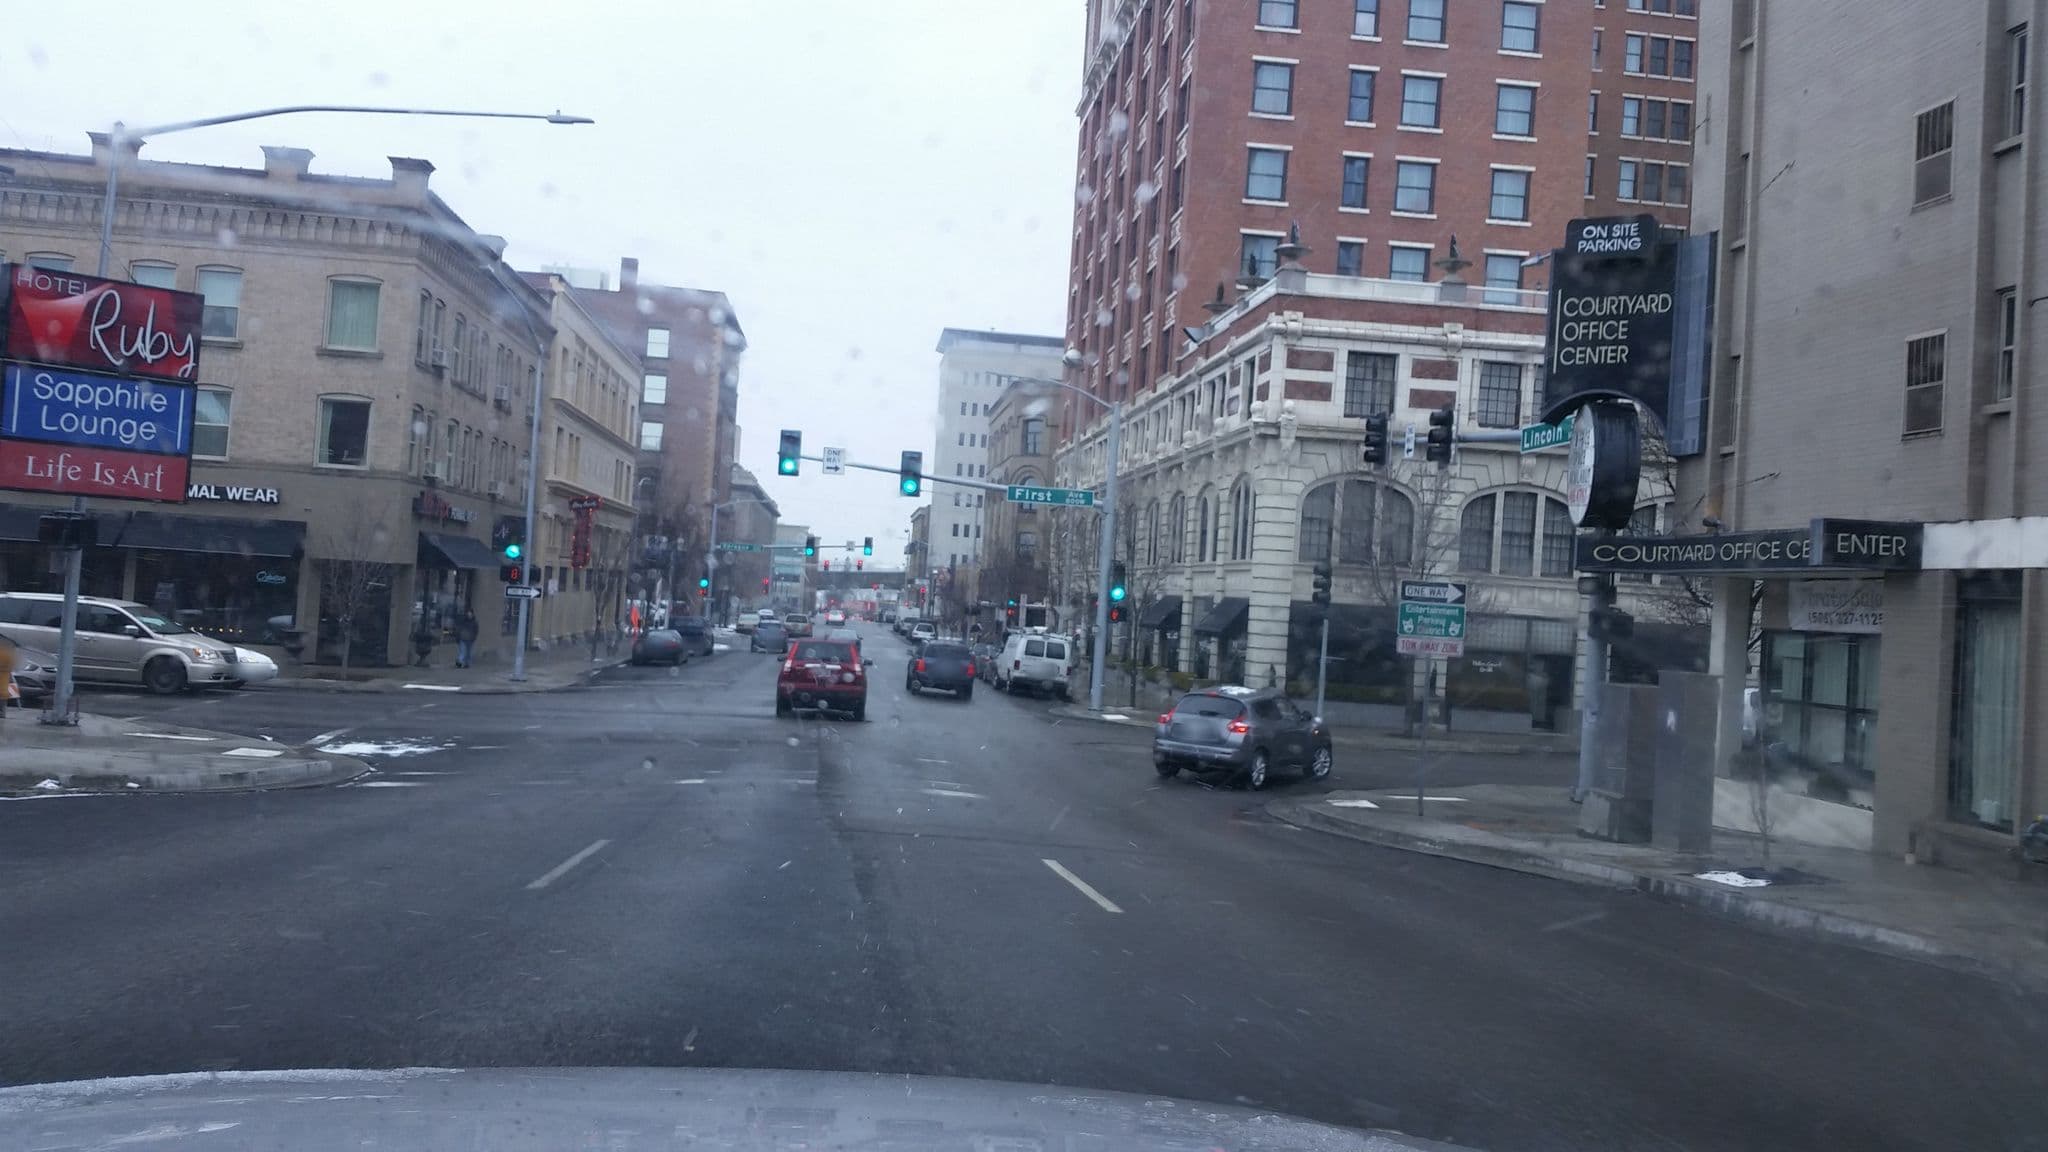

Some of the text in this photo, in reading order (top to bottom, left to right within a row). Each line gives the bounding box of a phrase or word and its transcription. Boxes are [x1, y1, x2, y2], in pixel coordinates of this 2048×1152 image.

[1582, 223, 1640, 239] ON SITE
[1577, 237, 1642, 253] PARKING
[15, 273, 88, 296] HOTEL
[1562, 293, 1672, 317] COURTYARD
[89, 288, 197, 379] Ruby
[1562, 319, 1629, 342] OFFICE
[1559, 345, 1629, 366] CENTER
[32, 372, 168, 413] Sapphire
[40, 404, 157, 445] Lounge
[25, 453, 165, 493] Life Is Art
[226, 485, 279, 503] WEAR
[1014, 487, 1053, 502] First
[1068, 490, 1084, 498] Ave
[1593, 544, 1716, 562] COURTYARD
[1719, 541, 1782, 561] OFFICE
[1837, 533, 1907, 557] ENTER
[1406, 586, 1448, 598] ONE WAY
